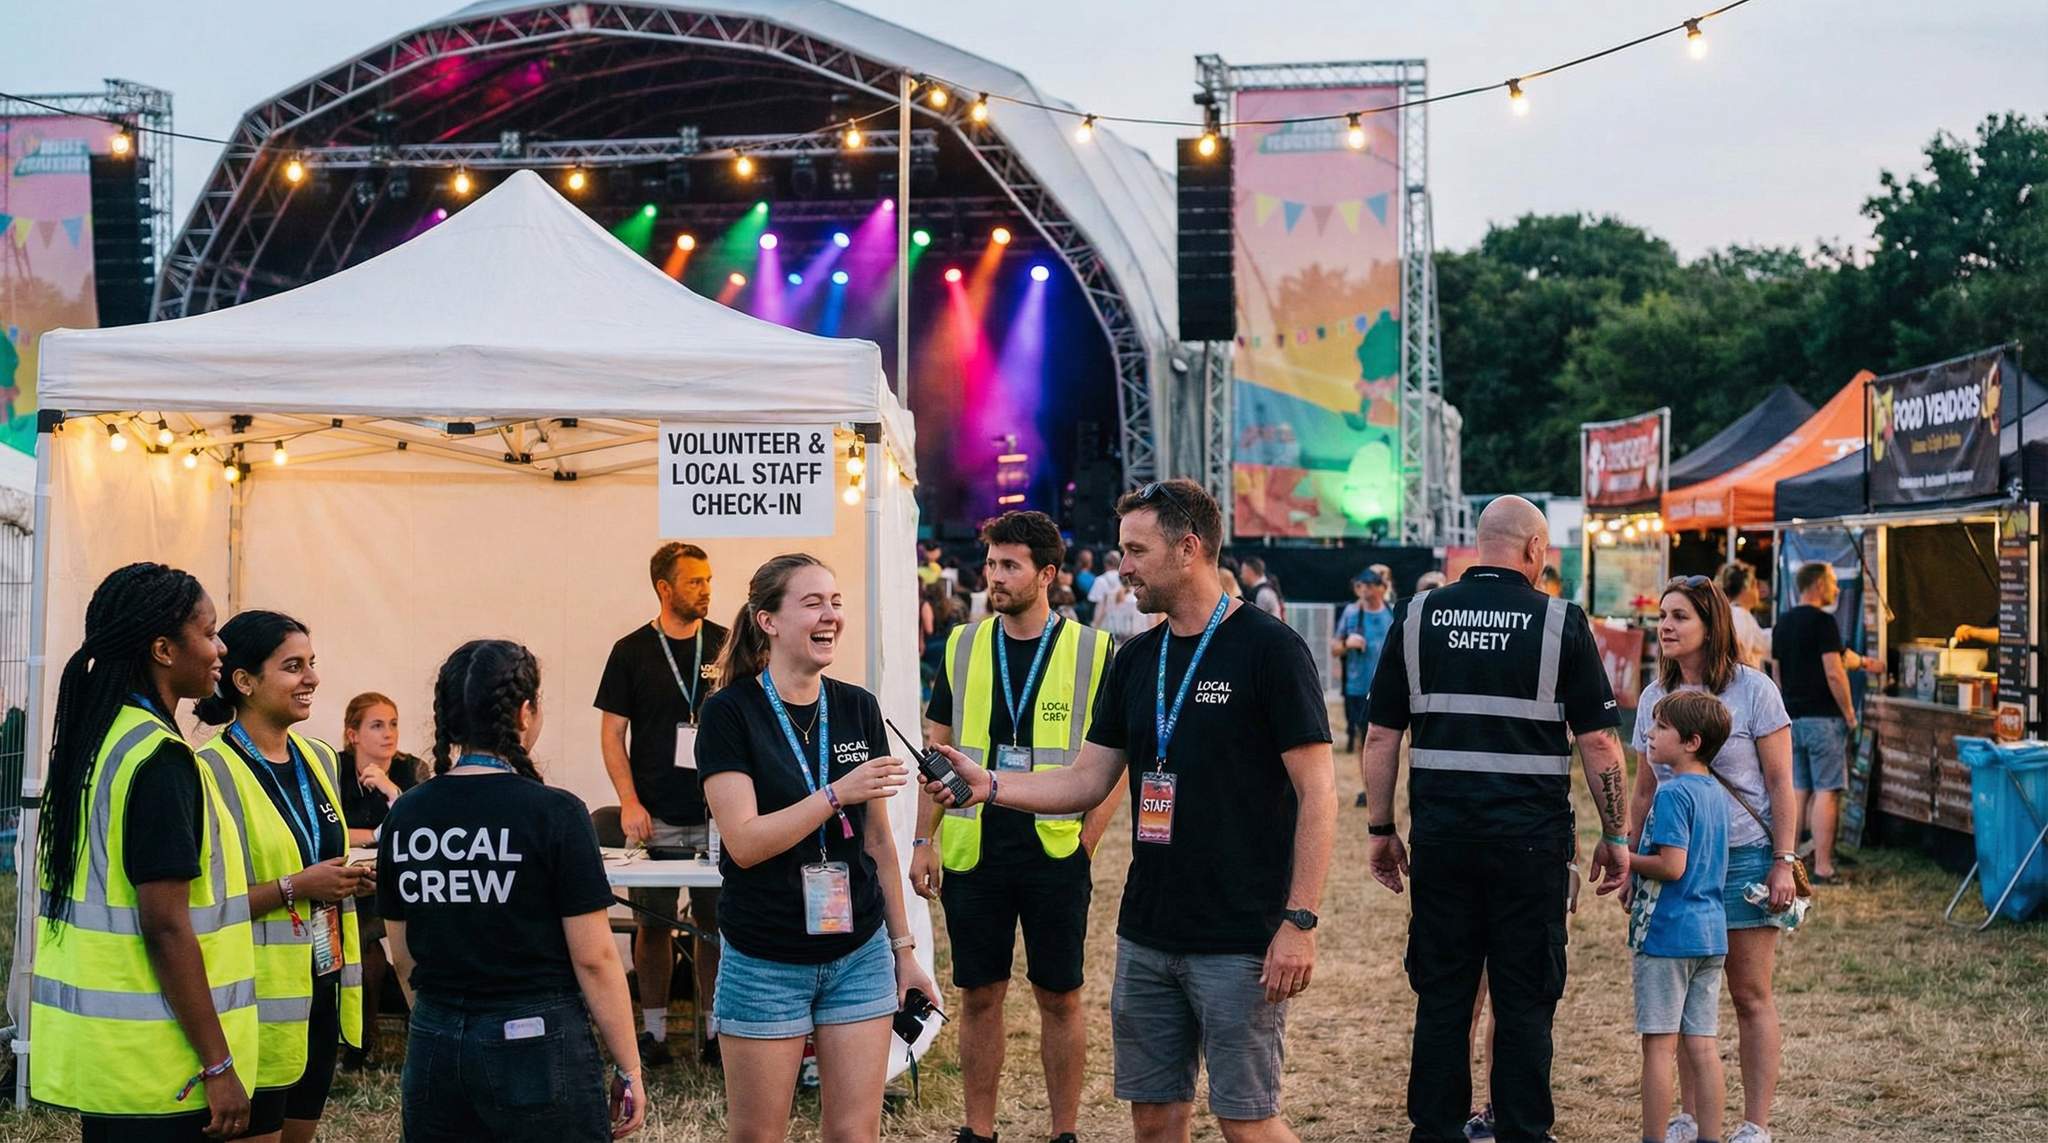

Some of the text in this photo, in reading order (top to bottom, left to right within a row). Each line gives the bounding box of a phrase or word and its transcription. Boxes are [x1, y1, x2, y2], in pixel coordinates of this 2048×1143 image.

[1925, 383, 1981, 426] VENDORS
[668, 432, 826, 455] VOLUNTEER &
[672, 462, 822, 485] LOCAL STAFF
[692, 493, 802, 515] CHECK-IN
[1431, 608, 1533, 630] COMMUNITY
[1448, 630, 1511, 651] SAFETY
[1197, 680, 1232, 692] LOCAL
[1041, 702, 1070, 711] LOCAL
[1195, 692, 1229, 704] CREW
[833, 740, 870, 754] LOCAL
[837, 751, 869, 763] CREW
[1142, 798, 1172, 812] STAFF
[392, 827, 523, 863] LOCAL
[399, 869, 516, 904] CREW
